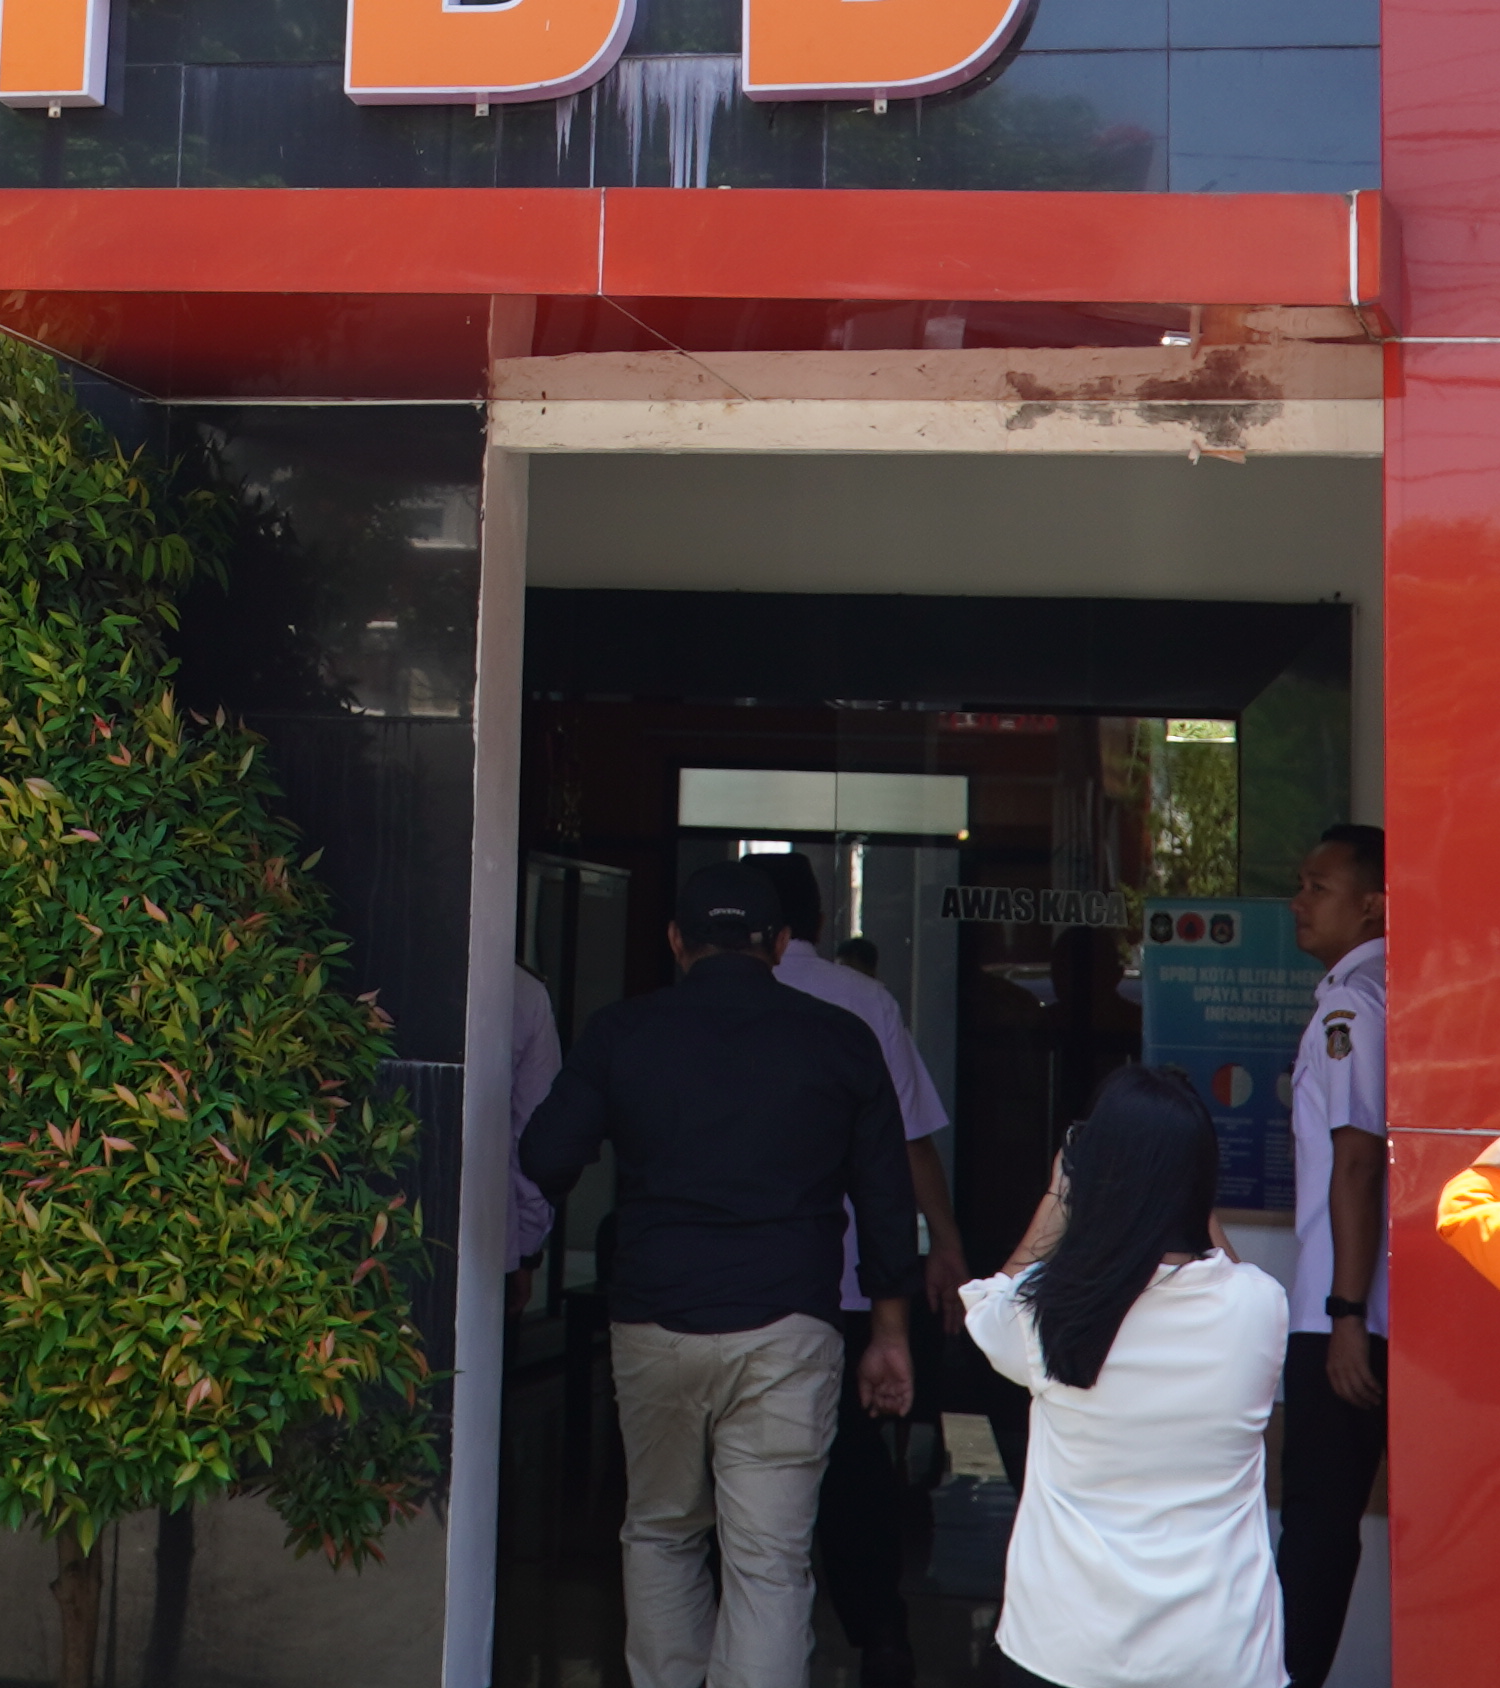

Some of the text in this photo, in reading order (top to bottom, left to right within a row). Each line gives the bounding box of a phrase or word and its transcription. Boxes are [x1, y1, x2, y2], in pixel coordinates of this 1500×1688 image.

[941, 885, 1129, 927] AWAS KACA
[1199, 966, 1235, 982] KOTA
[1237, 967, 1286, 984] BLITAR
[1204, 1005, 1280, 1023] INFORMASI
